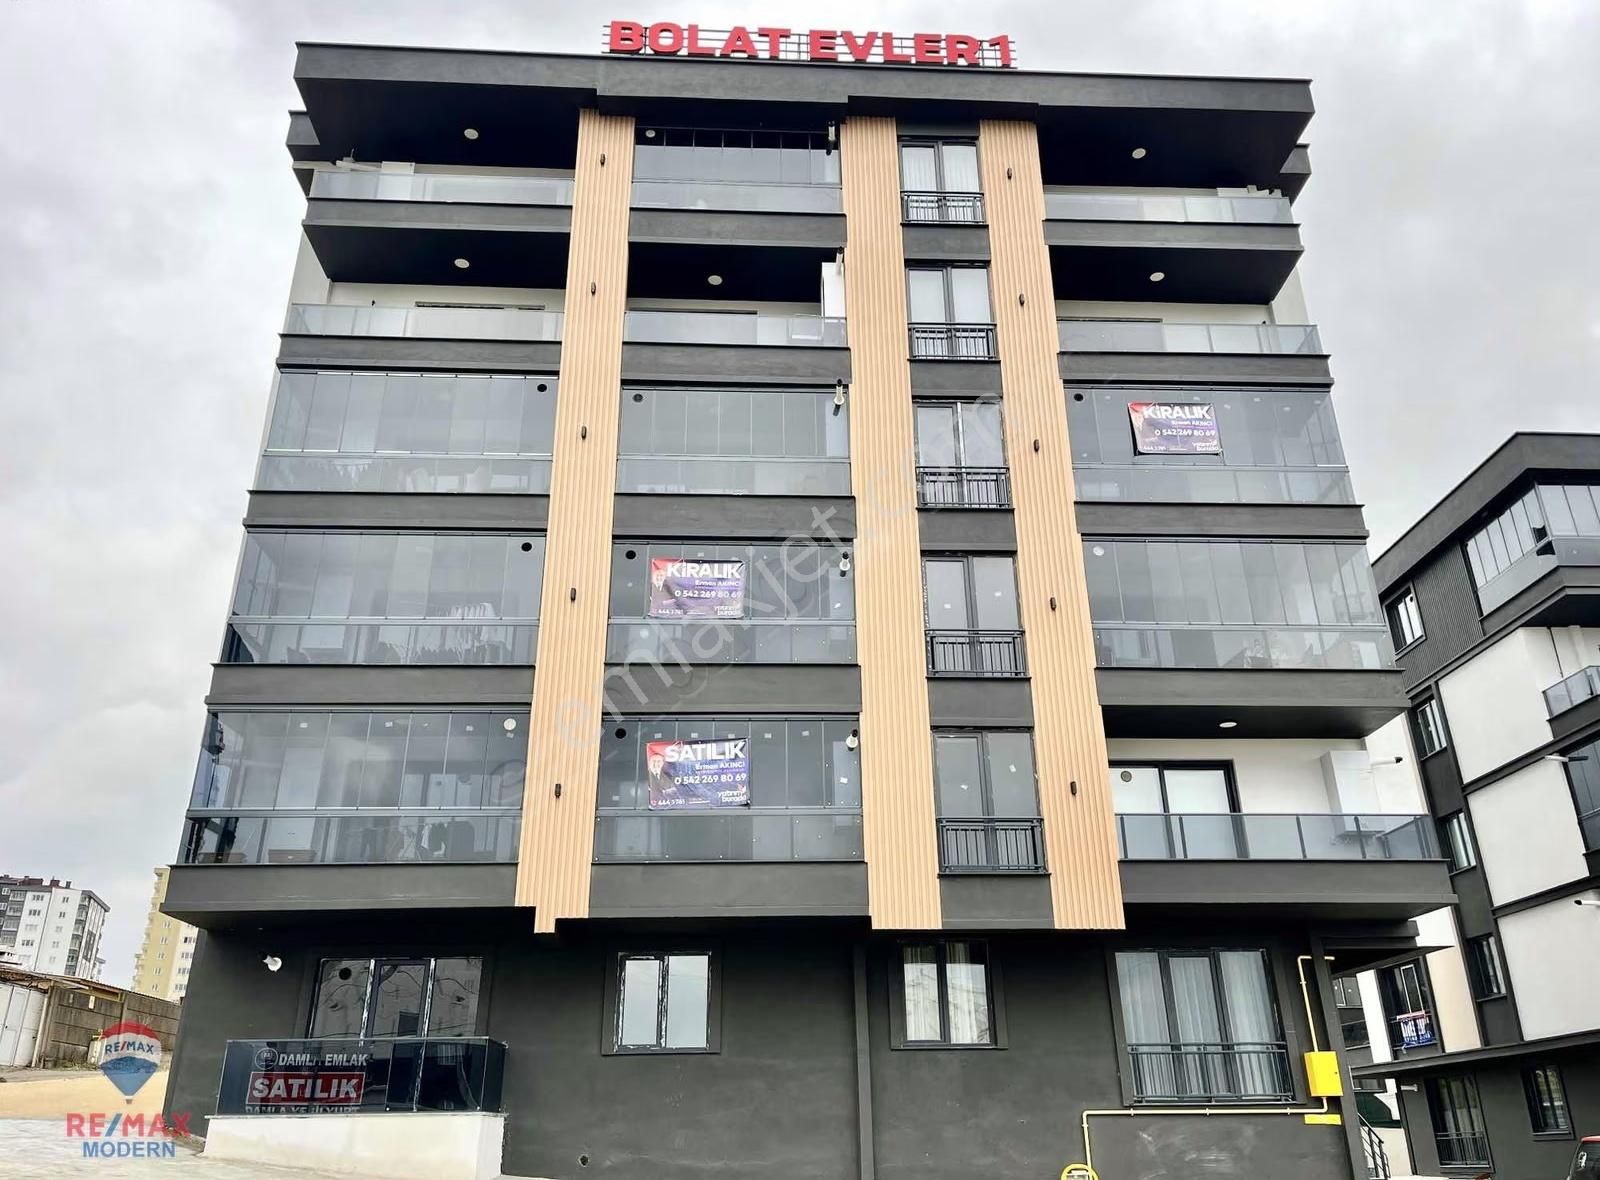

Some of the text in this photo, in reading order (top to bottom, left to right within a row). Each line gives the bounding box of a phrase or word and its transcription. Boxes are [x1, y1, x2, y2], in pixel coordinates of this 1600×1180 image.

[608, 20, 792, 60] BOLAT
[700, 590, 716, 598] 269
[717, 590, 729, 598] 80
[731, 590, 742, 598] 69
[664, 741, 745, 762] SATILIK
[674, 773, 747, 785] 0 542 269 80 69
[324, 1053, 368, 1067] EMLAK
[252, 1078, 360, 1098] SATILIK
